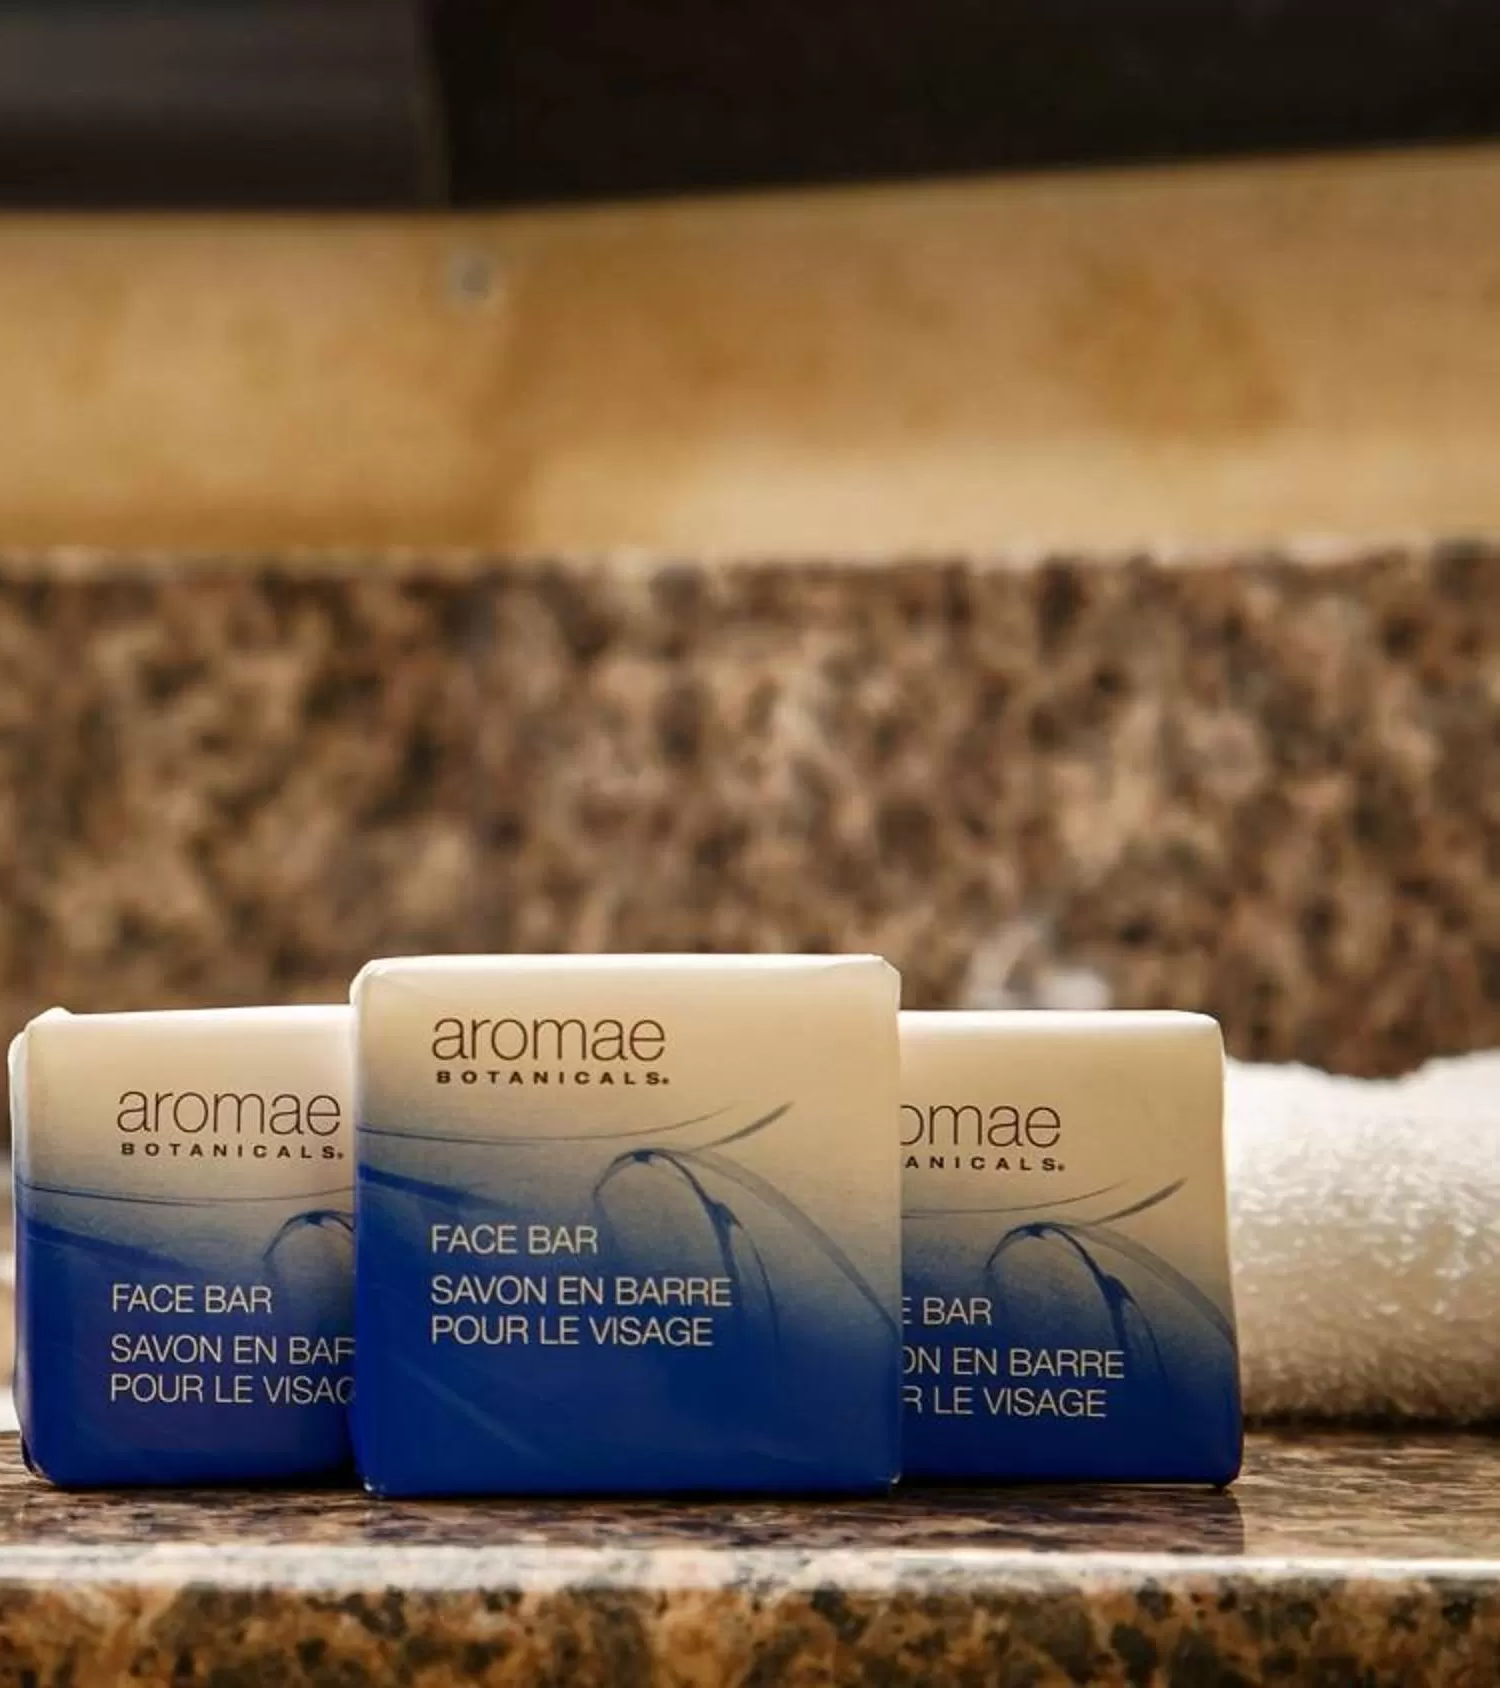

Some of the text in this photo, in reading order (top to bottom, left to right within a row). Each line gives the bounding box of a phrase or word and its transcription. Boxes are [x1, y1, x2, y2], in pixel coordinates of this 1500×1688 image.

[432, 1017, 666, 1062] aromae
[116, 1090, 341, 1136] aromae
[900, 1104, 1061, 1148] omae
[904, 1155, 1058, 1171] ANICALS
[431, 1224, 599, 1255] FACE BAR
[111, 1283, 272, 1315] FACE BAR
[431, 1275, 732, 1307] SAVON EN BARRE
[923, 1297, 992, 1326] BAR
[431, 1316, 714, 1347] POUR LE VISAGE
[110, 1335, 222, 1365] SAVON
[235, 1336, 277, 1365] EN
[953, 1347, 997, 1376] EN
[1009, 1348, 1126, 1379] BARRE
[110, 1374, 204, 1404] POUR
[215, 1376, 253, 1404] LE
[934, 1386, 975, 1415] LE
[983, 1388, 1108, 1418] VISAGE
